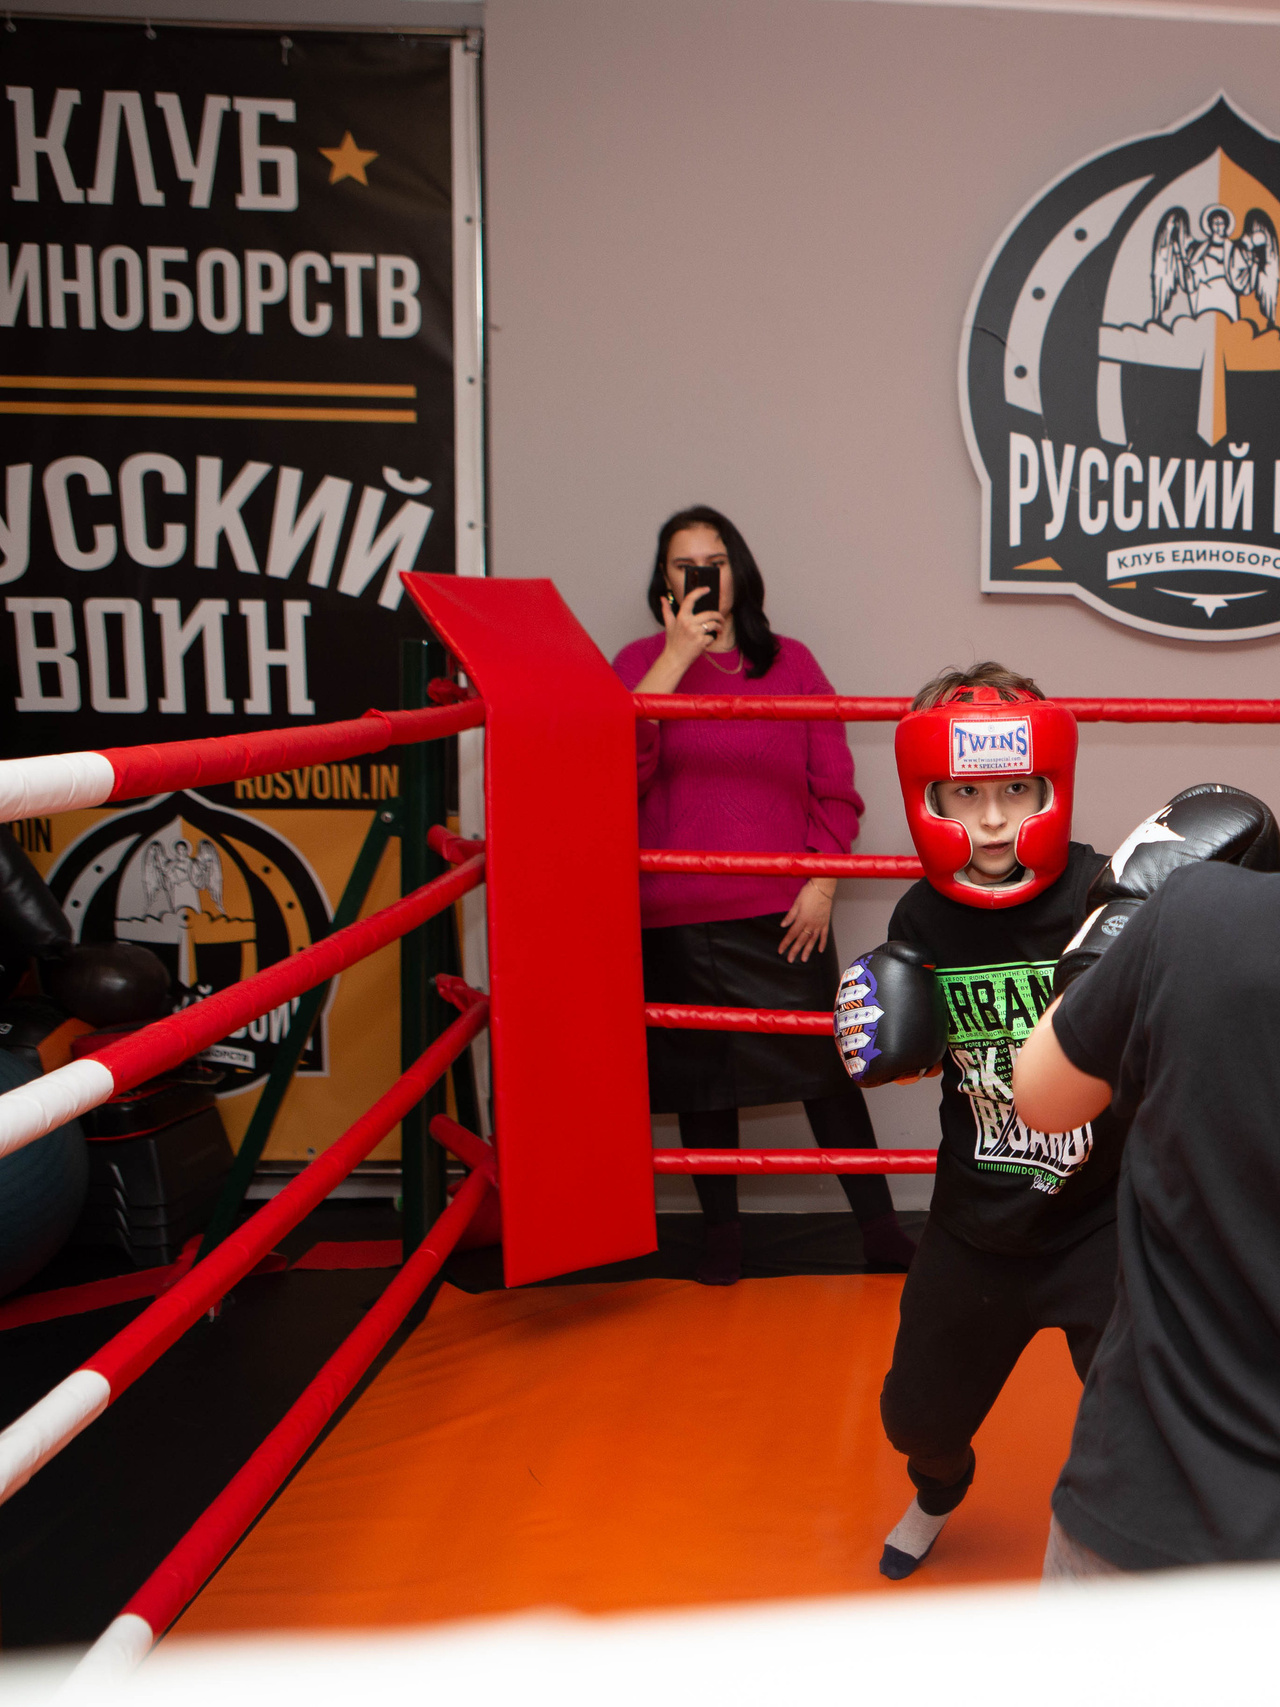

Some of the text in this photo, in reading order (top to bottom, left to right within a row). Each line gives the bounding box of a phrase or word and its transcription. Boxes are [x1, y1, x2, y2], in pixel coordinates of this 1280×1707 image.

[6, 85, 299, 212] КЛУБ
[0, 242, 422, 338] ИНОБОРСТВ
[1009, 431, 1254, 548] РУССКИЙ
[1117, 551, 1165, 569] КЛУБ
[6, 597, 315, 715] ВОИН
[955, 725, 1027, 758] TWINS
